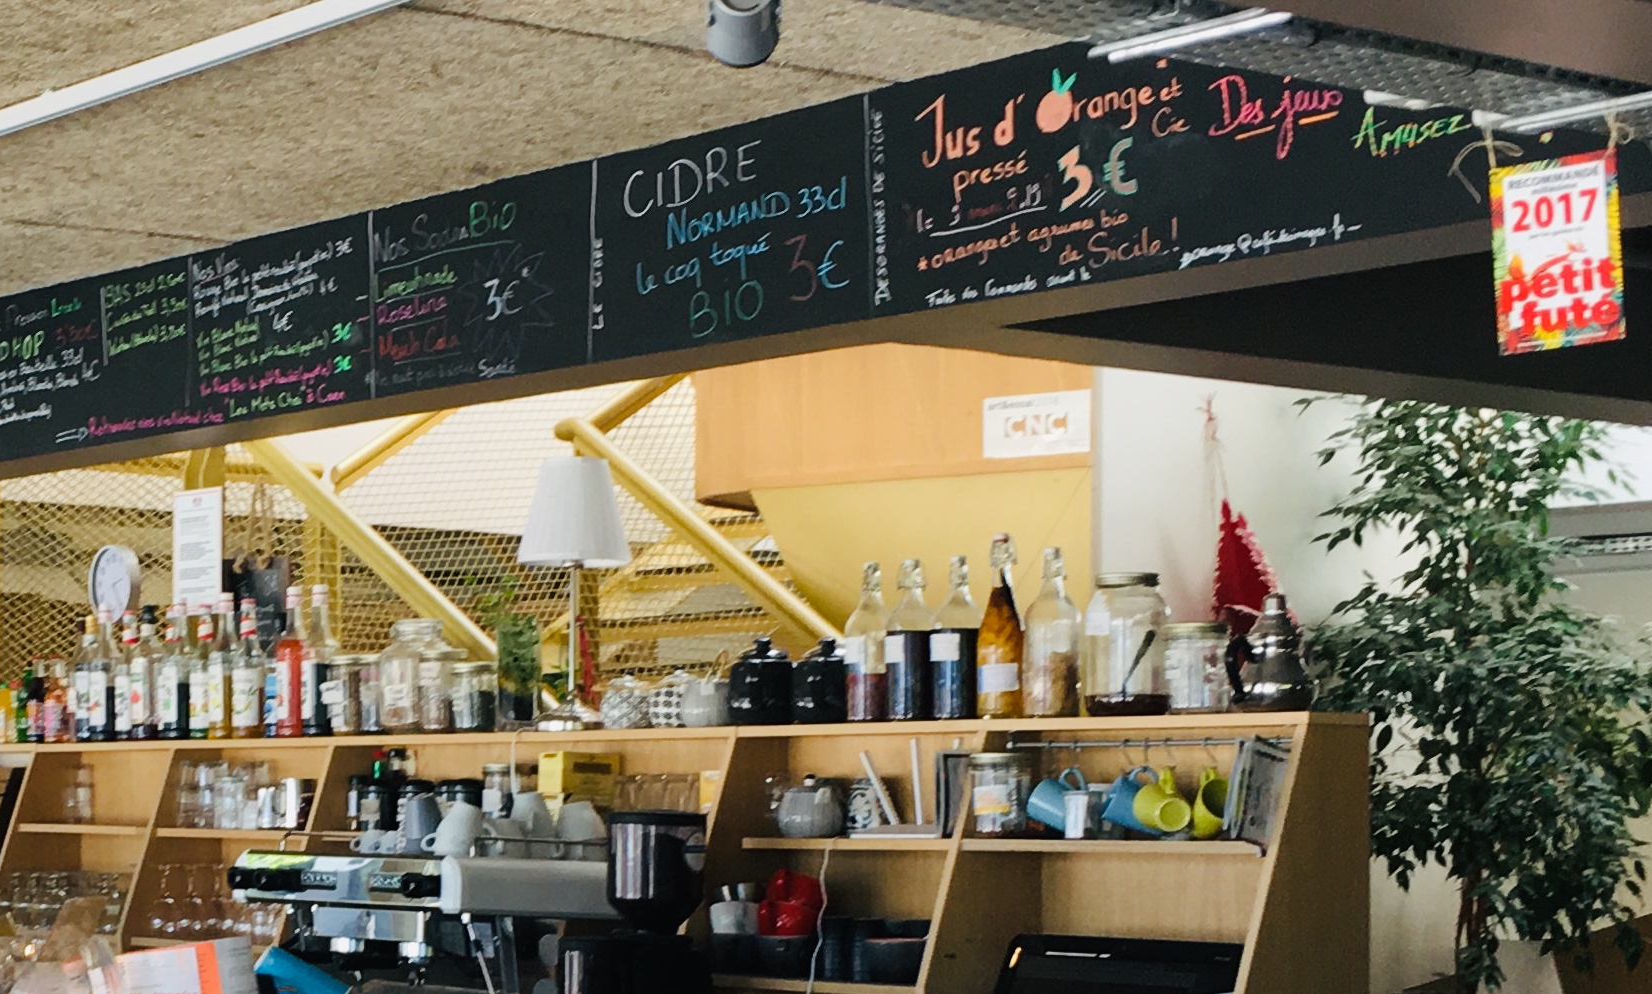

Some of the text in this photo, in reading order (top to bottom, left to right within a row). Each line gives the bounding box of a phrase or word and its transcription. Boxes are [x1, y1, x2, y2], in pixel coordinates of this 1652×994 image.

[915, 93, 981, 168] Jus
[1208, 74, 1344, 160] Des jeux
[623, 139, 762, 219] CIDRE
[952, 149, 1029, 203] pressé
[665, 175, 847, 250] NORMAND 33cl
[1511, 187, 1599, 234] 2017
[663, 257, 702, 288] coq
[709, 230, 772, 281] toqué
[1501, 257, 1617, 313] petit
[1519, 292, 1621, 335] futé
[12, 329, 46, 360] HOP
[1003, 410, 1070, 438] CNC
